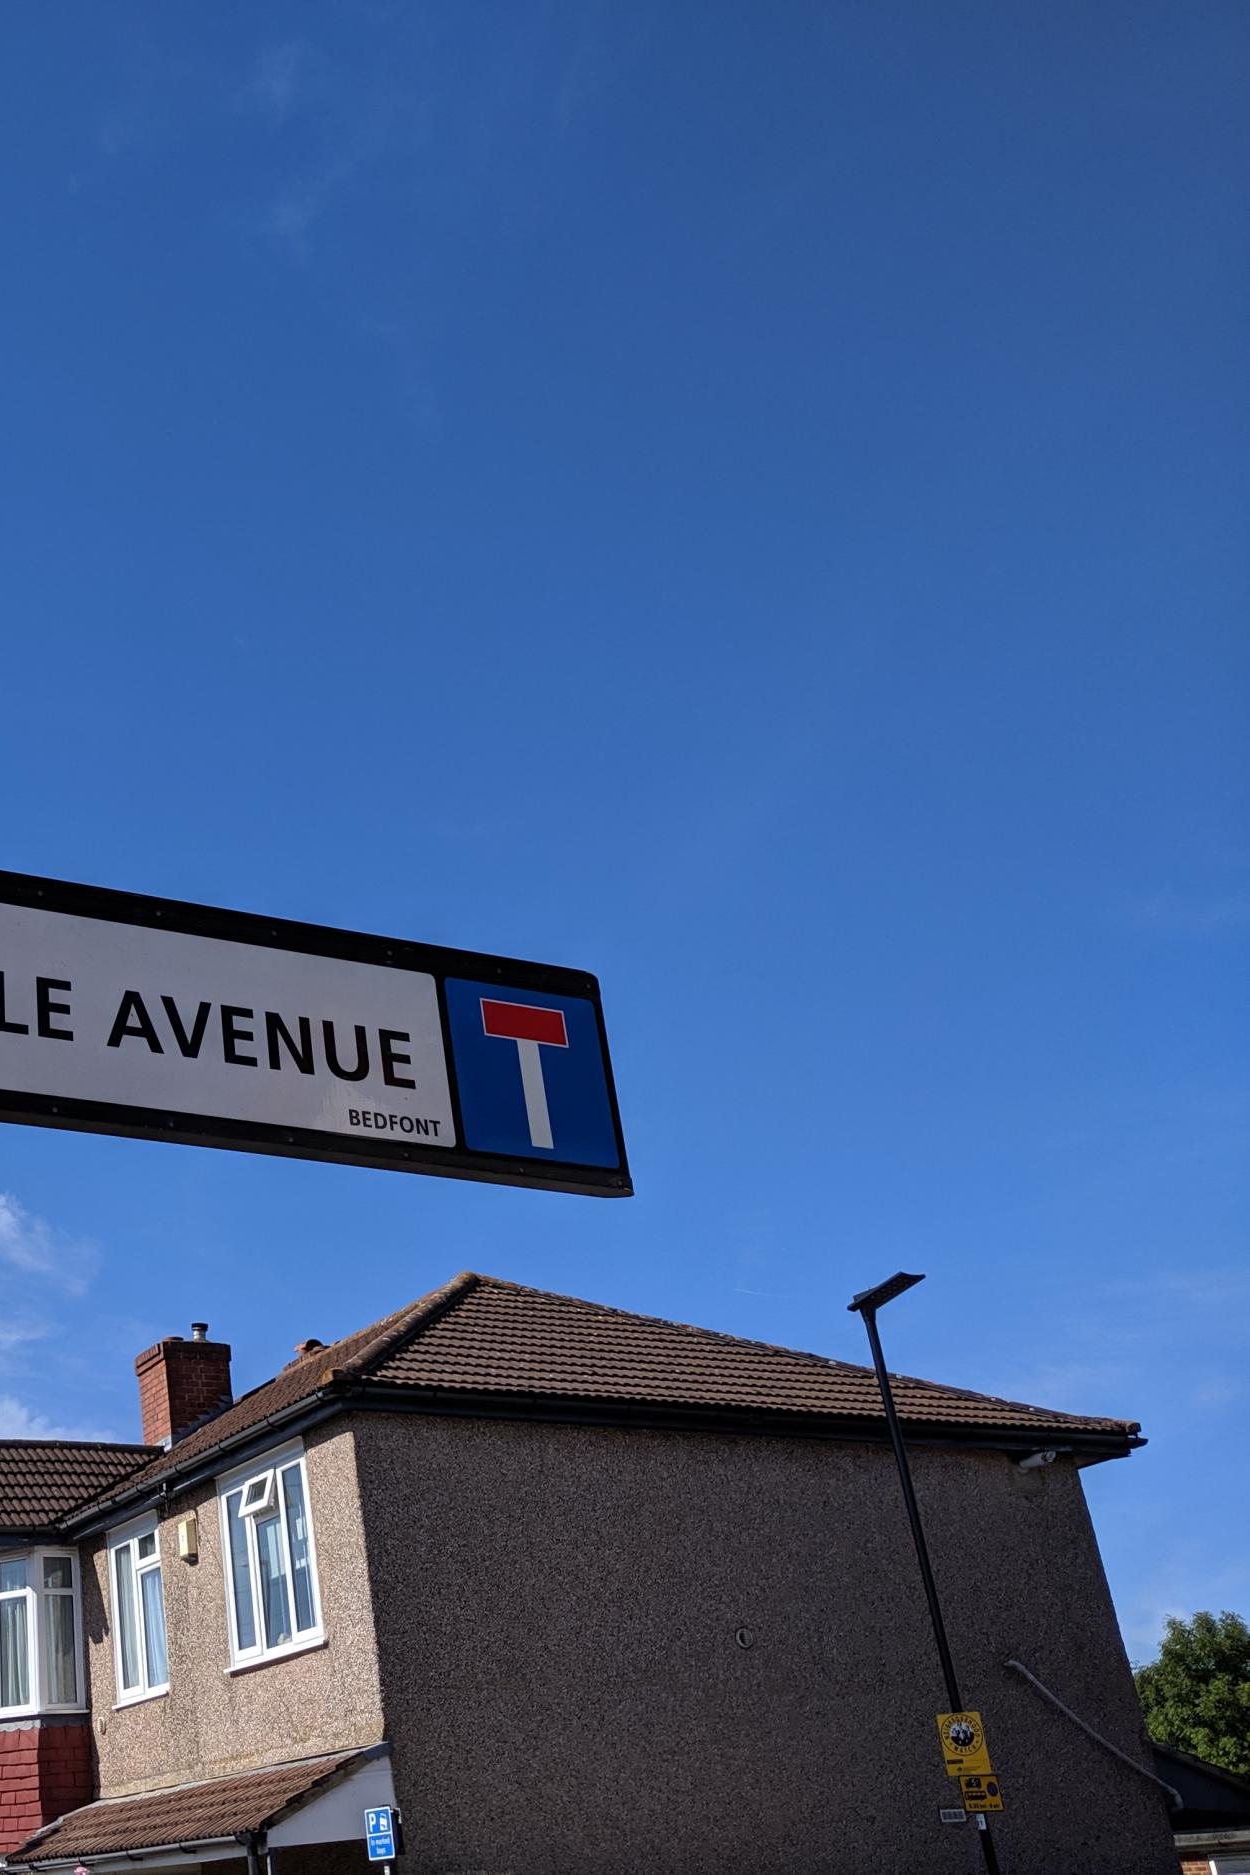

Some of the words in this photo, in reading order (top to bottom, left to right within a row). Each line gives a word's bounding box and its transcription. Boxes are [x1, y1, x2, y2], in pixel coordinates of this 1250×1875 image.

[106, 989, 417, 1090] AVENUE
[348, 1108, 441, 1137] BEDFONT
[954, 1745, 977, 1753] WATCH
[369, 1813, 376, 1832] P
